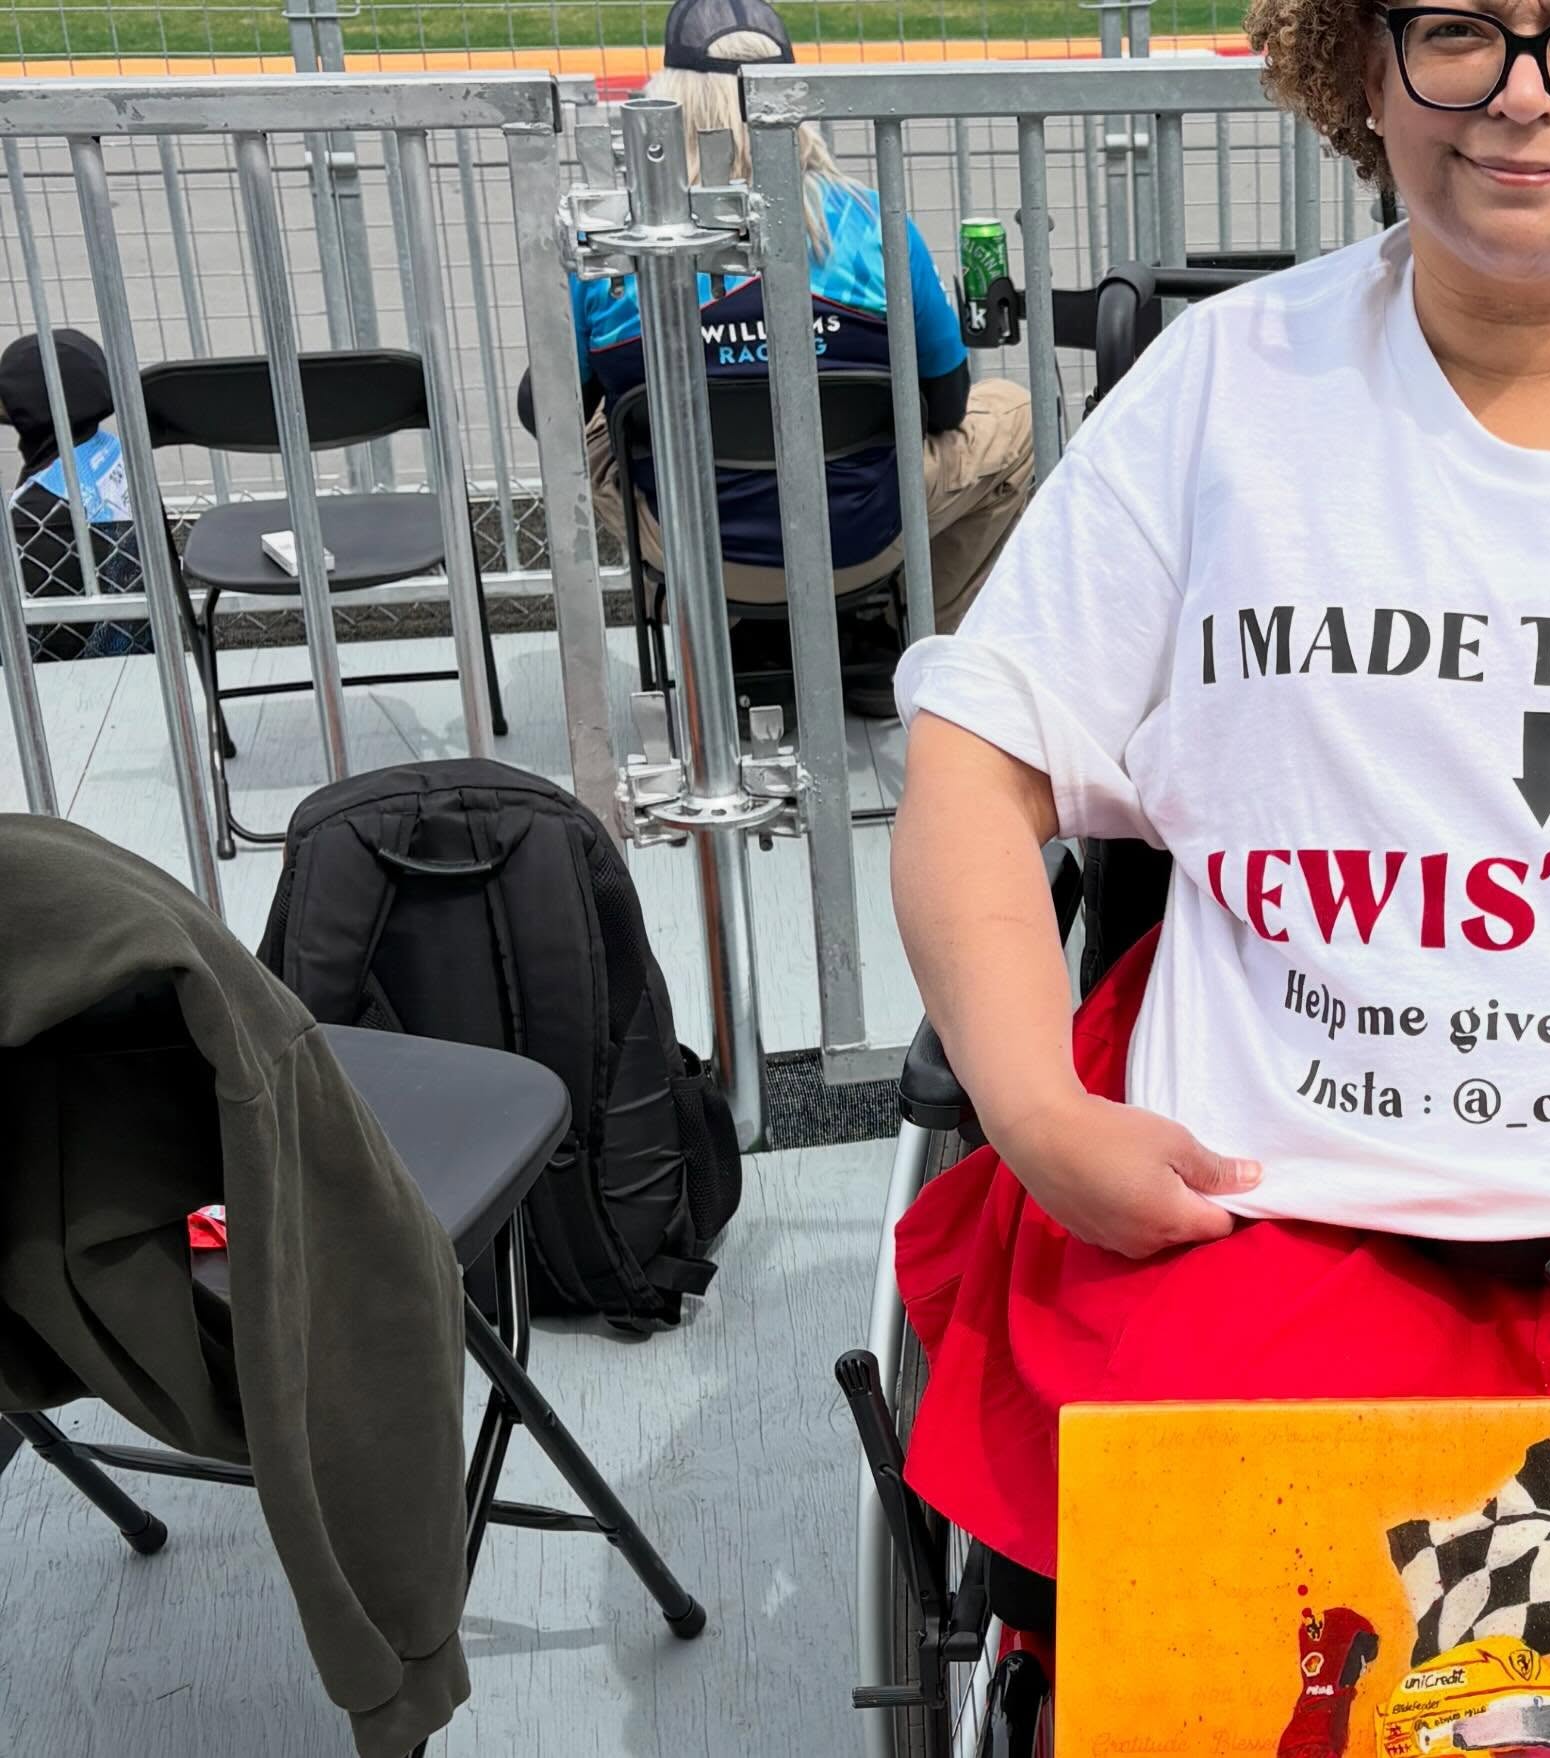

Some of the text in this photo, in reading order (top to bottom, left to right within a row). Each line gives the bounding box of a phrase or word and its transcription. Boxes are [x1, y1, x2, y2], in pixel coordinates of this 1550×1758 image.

[1203, 615, 1216, 684] I
[1239, 606, 1488, 681] MADE
[1285, 970, 1345, 1040] Help
[1358, 1007, 1427, 1035] me
[1298, 1060, 1402, 1117] Insta
[1404, 1668, 1465, 1689] uniCredit
